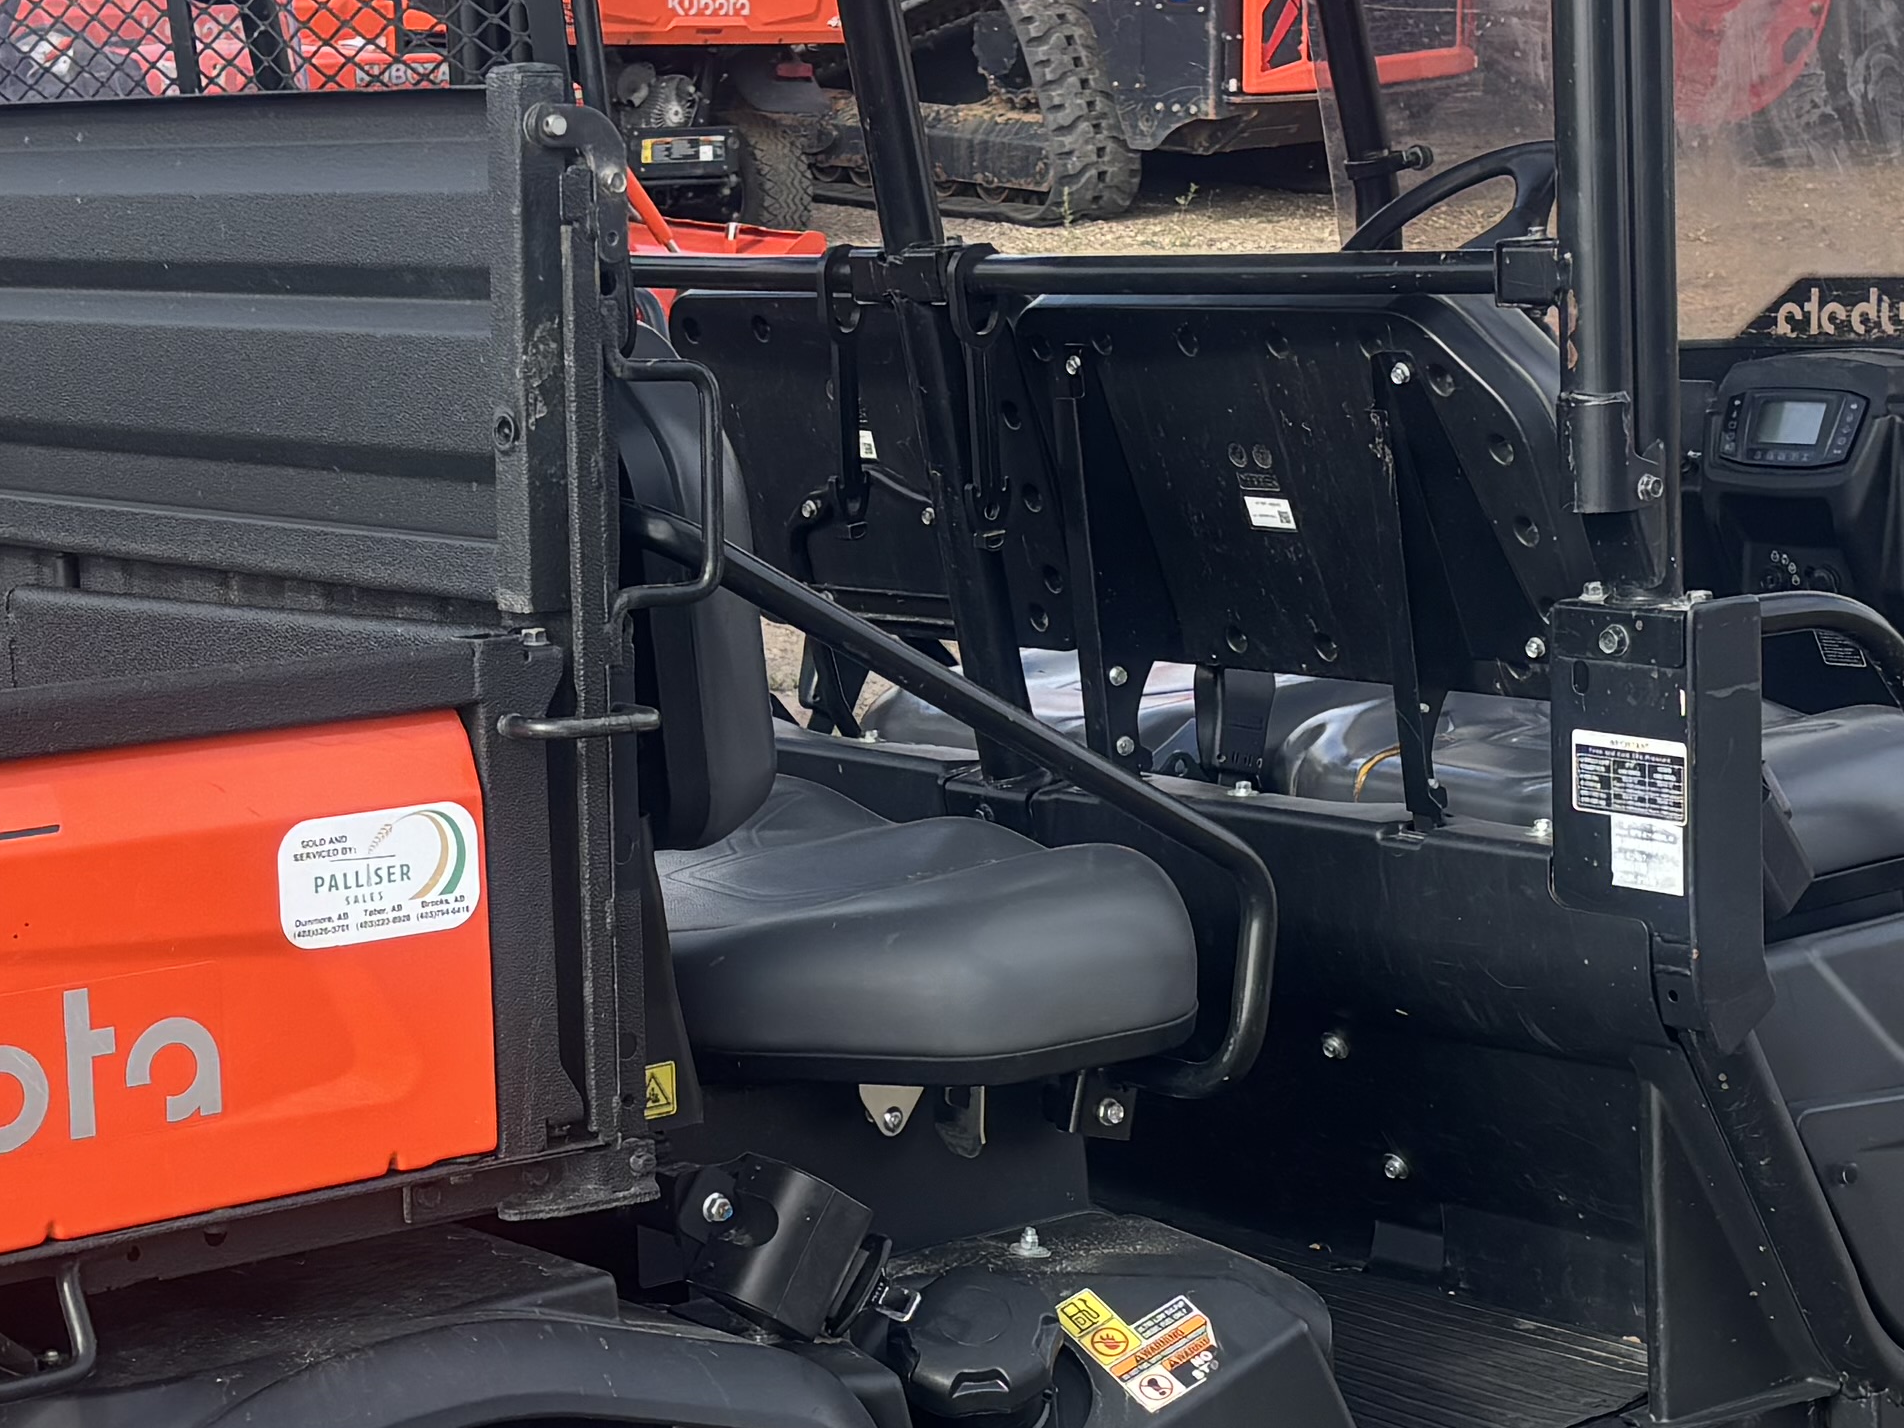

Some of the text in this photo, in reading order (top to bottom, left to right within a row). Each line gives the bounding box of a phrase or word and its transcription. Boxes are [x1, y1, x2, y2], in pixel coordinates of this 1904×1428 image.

[301, 835, 348, 849] SOLD AND
[293, 848, 339, 862] SERVICED
[314, 863, 412, 894] PALLISER
[345, 891, 384, 906] SALES
